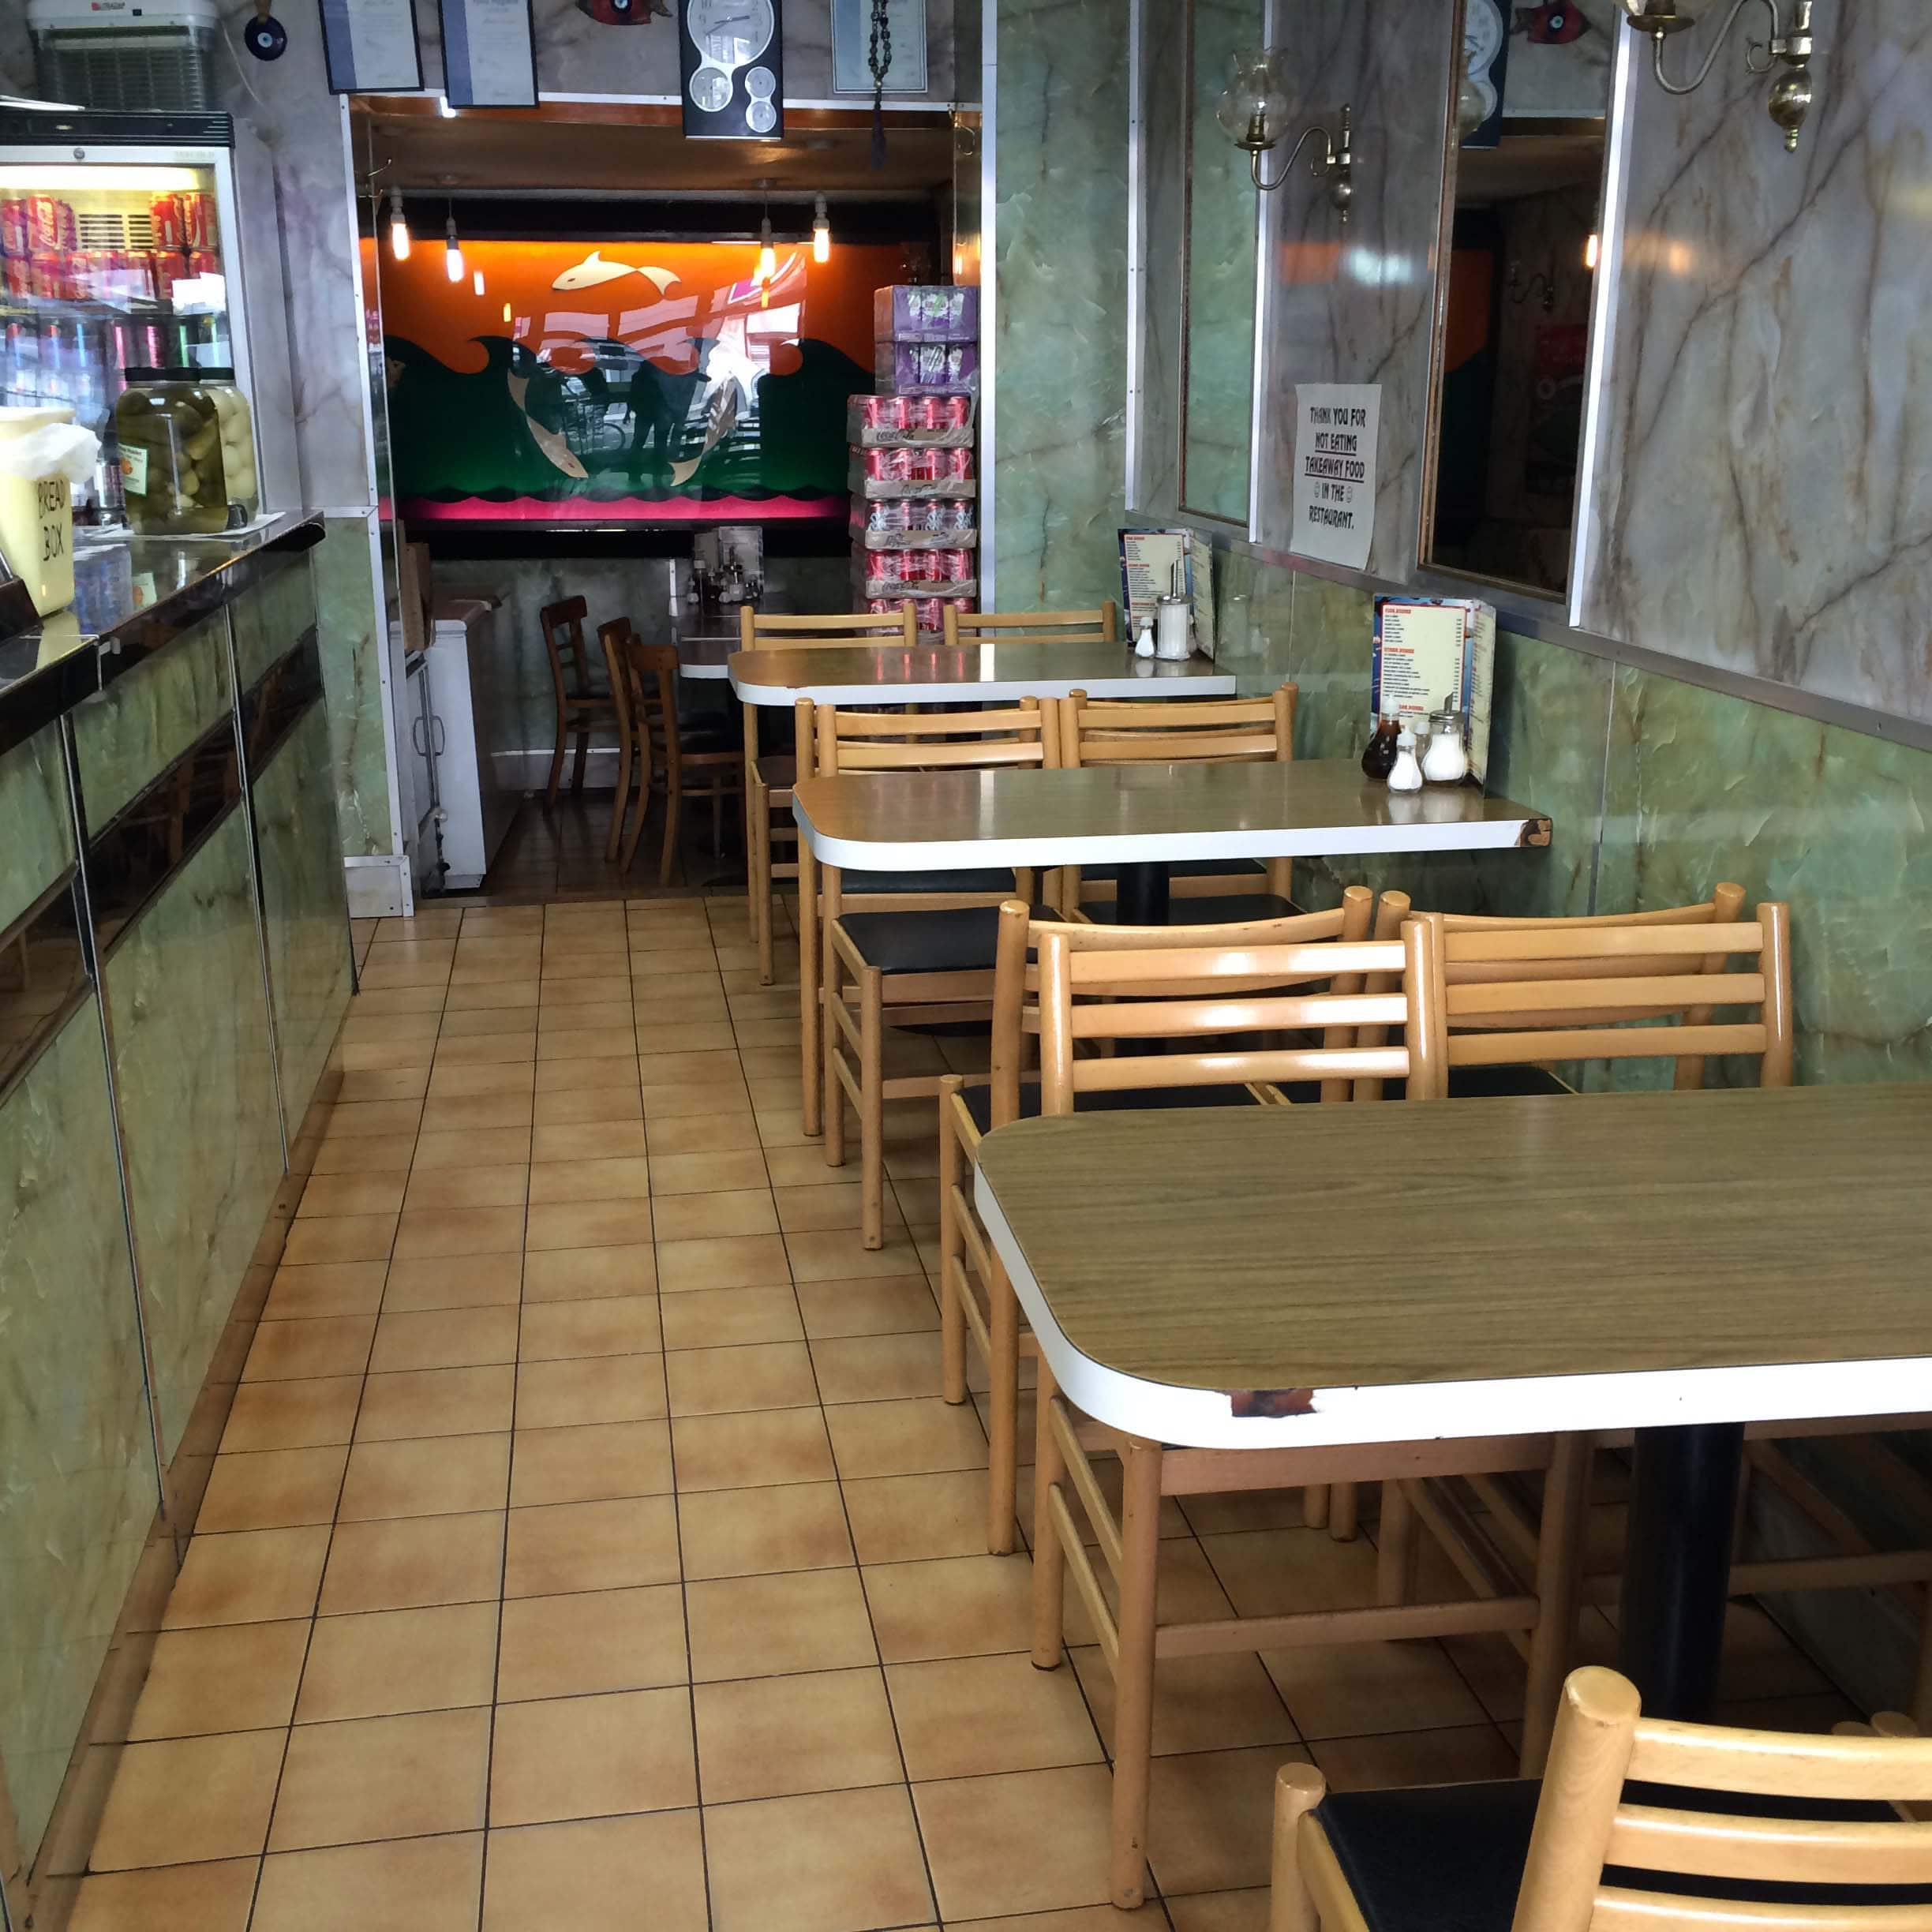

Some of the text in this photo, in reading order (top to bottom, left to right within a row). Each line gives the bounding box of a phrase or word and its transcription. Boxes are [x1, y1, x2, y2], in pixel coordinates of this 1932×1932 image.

[1309, 406, 1366, 428] THANK YOU FOR
[1315, 432, 1357, 452] NOT EATING
[1305, 455, 1365, 479] TAKEAWAY FOOD
[38, 479, 65, 519] BREAD
[1321, 482, 1345, 503] IN THE
[1309, 504, 1354, 530] RESTAURANT.
[43, 522, 64, 562] BOX
